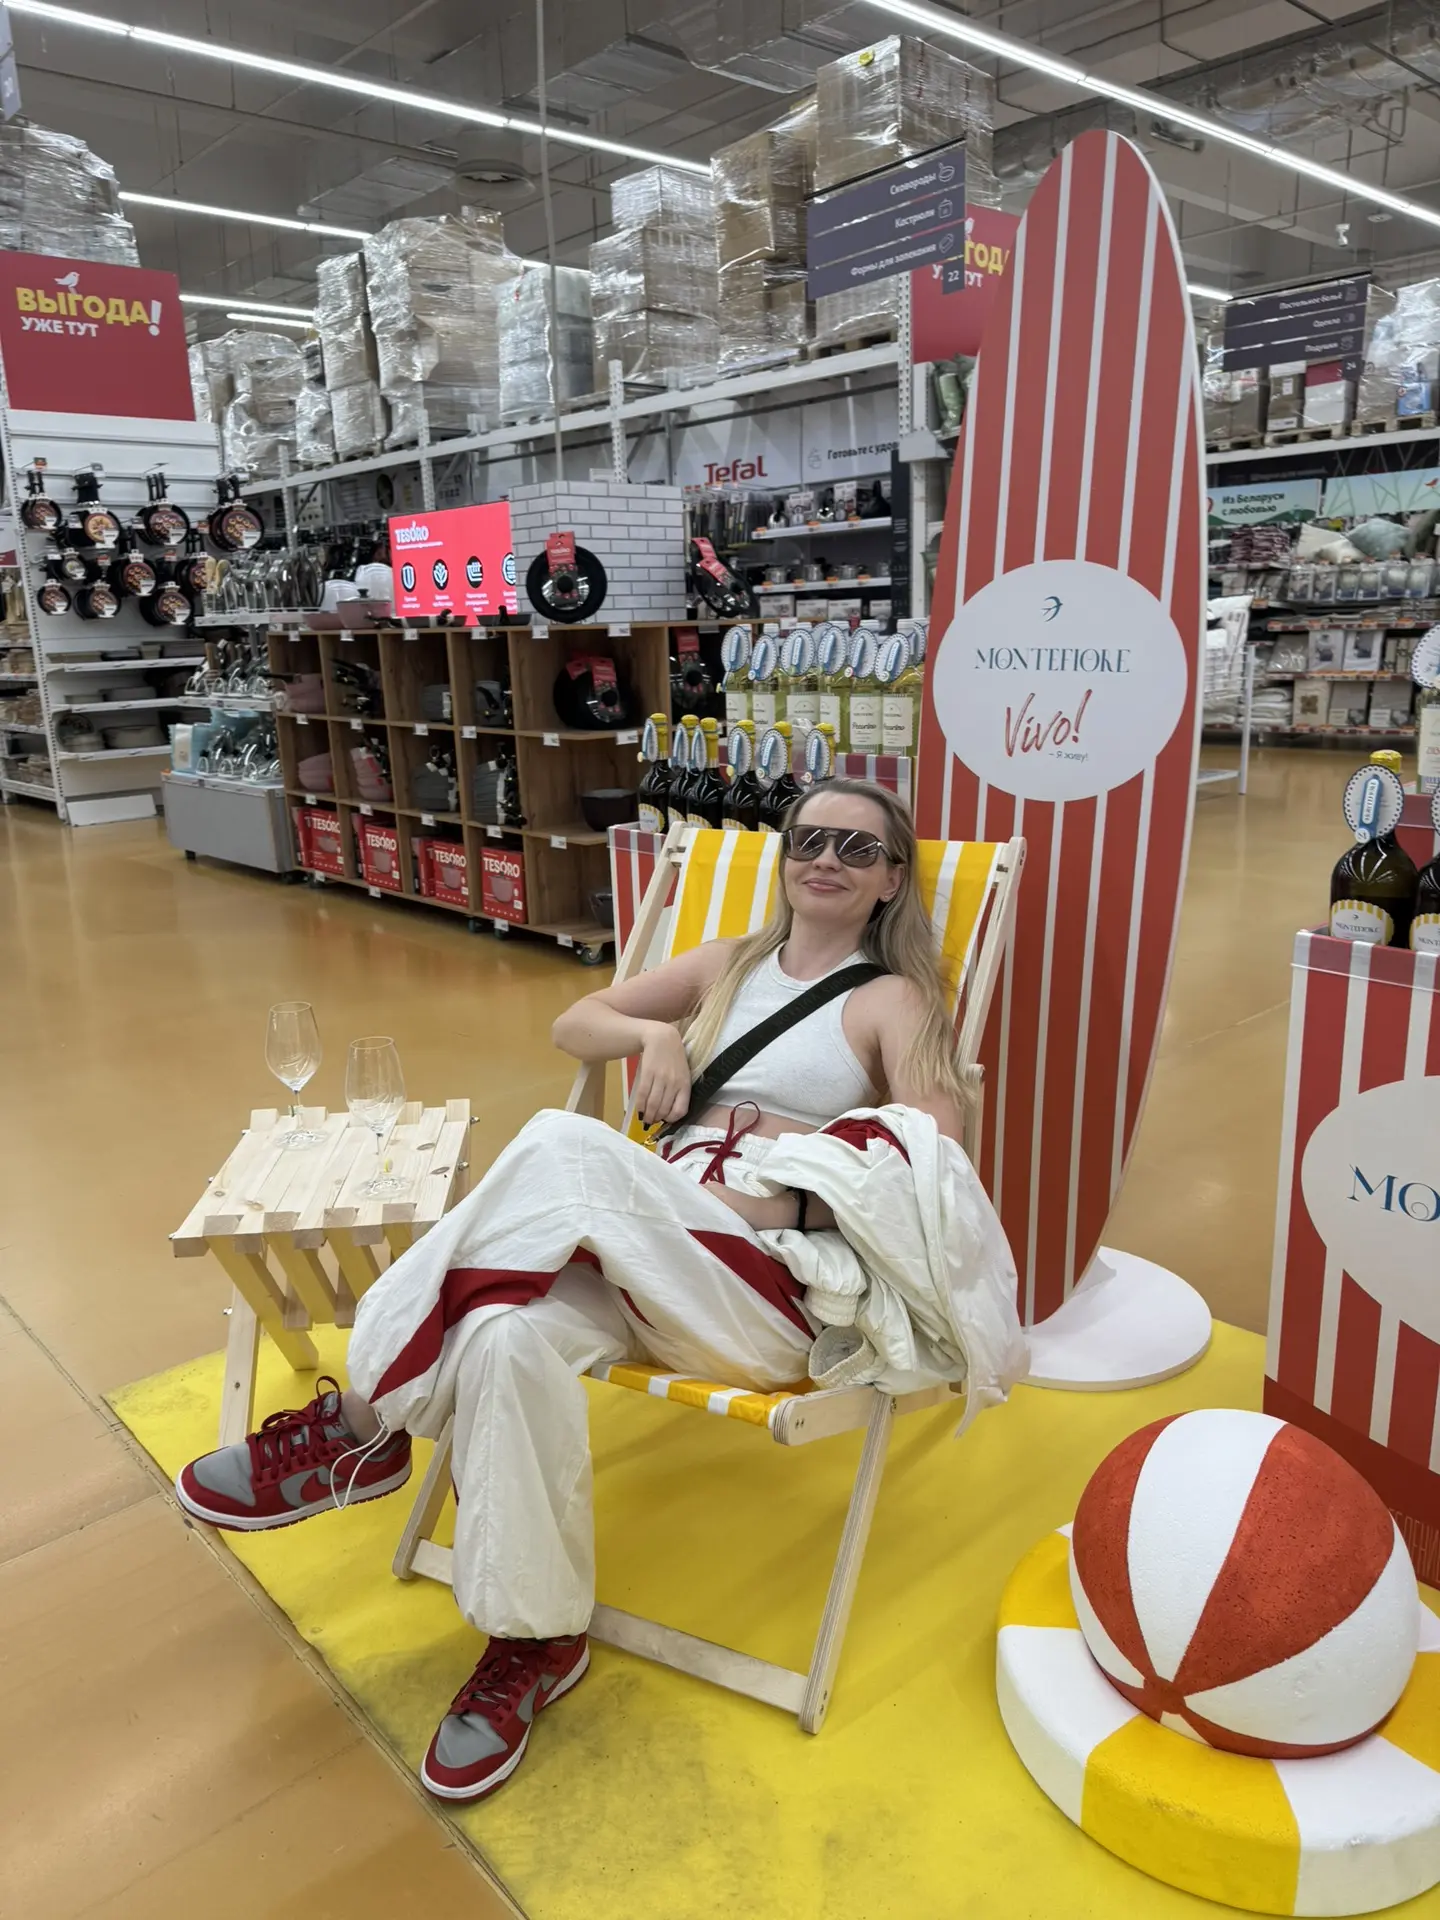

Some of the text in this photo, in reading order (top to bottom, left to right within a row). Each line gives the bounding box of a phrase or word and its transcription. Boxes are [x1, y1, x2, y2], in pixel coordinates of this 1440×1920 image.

[890, 173, 936, 195] Сковороды
[894, 208, 936, 229] Кастрюли
[850, 243, 937, 277] Формы для запекания
[964, 239, 1010, 277] ГОД
[947, 270, 960, 283] 22
[15, 286, 162, 337] ВЫГОДА!
[20, 315, 99, 338] УЖЕ ТУТ
[827, 446, 867, 460] Готовьте
[868, 445, 874, 454] с
[703, 455, 768, 486] Tefal
[1221, 492, 1285, 505] Из Беларуси
[1221, 504, 1277, 516] с любовью
[974, 647, 1131, 673] MONTEFIORE
[1005, 688, 1093, 758] Vivo!
[1056, 751, 1063, 759] Я
[1063, 752, 1089, 764] живу!
[1346, 1163, 1440, 1222] MO
